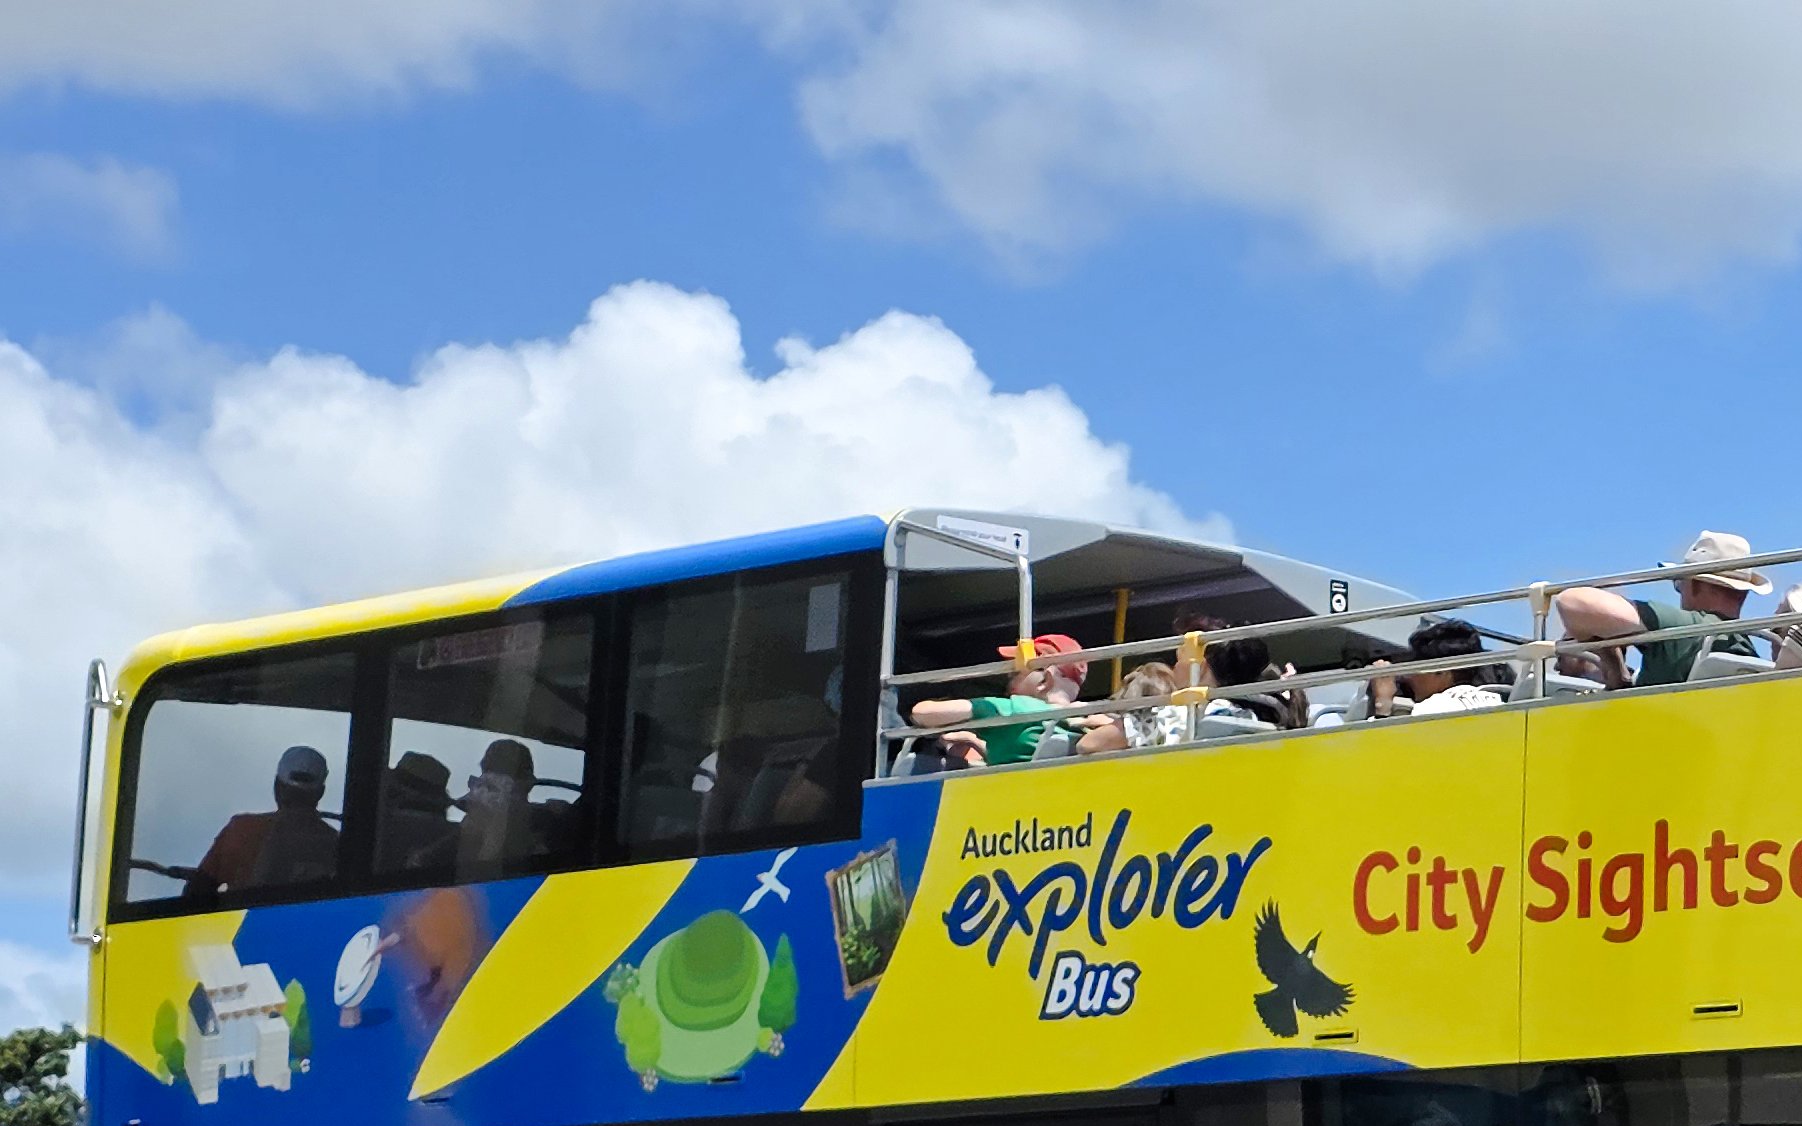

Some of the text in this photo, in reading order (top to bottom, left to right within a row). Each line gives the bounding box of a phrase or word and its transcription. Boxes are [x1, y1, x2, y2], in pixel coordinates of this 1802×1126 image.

[960, 811, 1093, 862] Auckland
[942, 808, 1274, 980] explorer
[1353, 844, 1506, 954] City
[1039, 950, 1143, 1021] Bus
